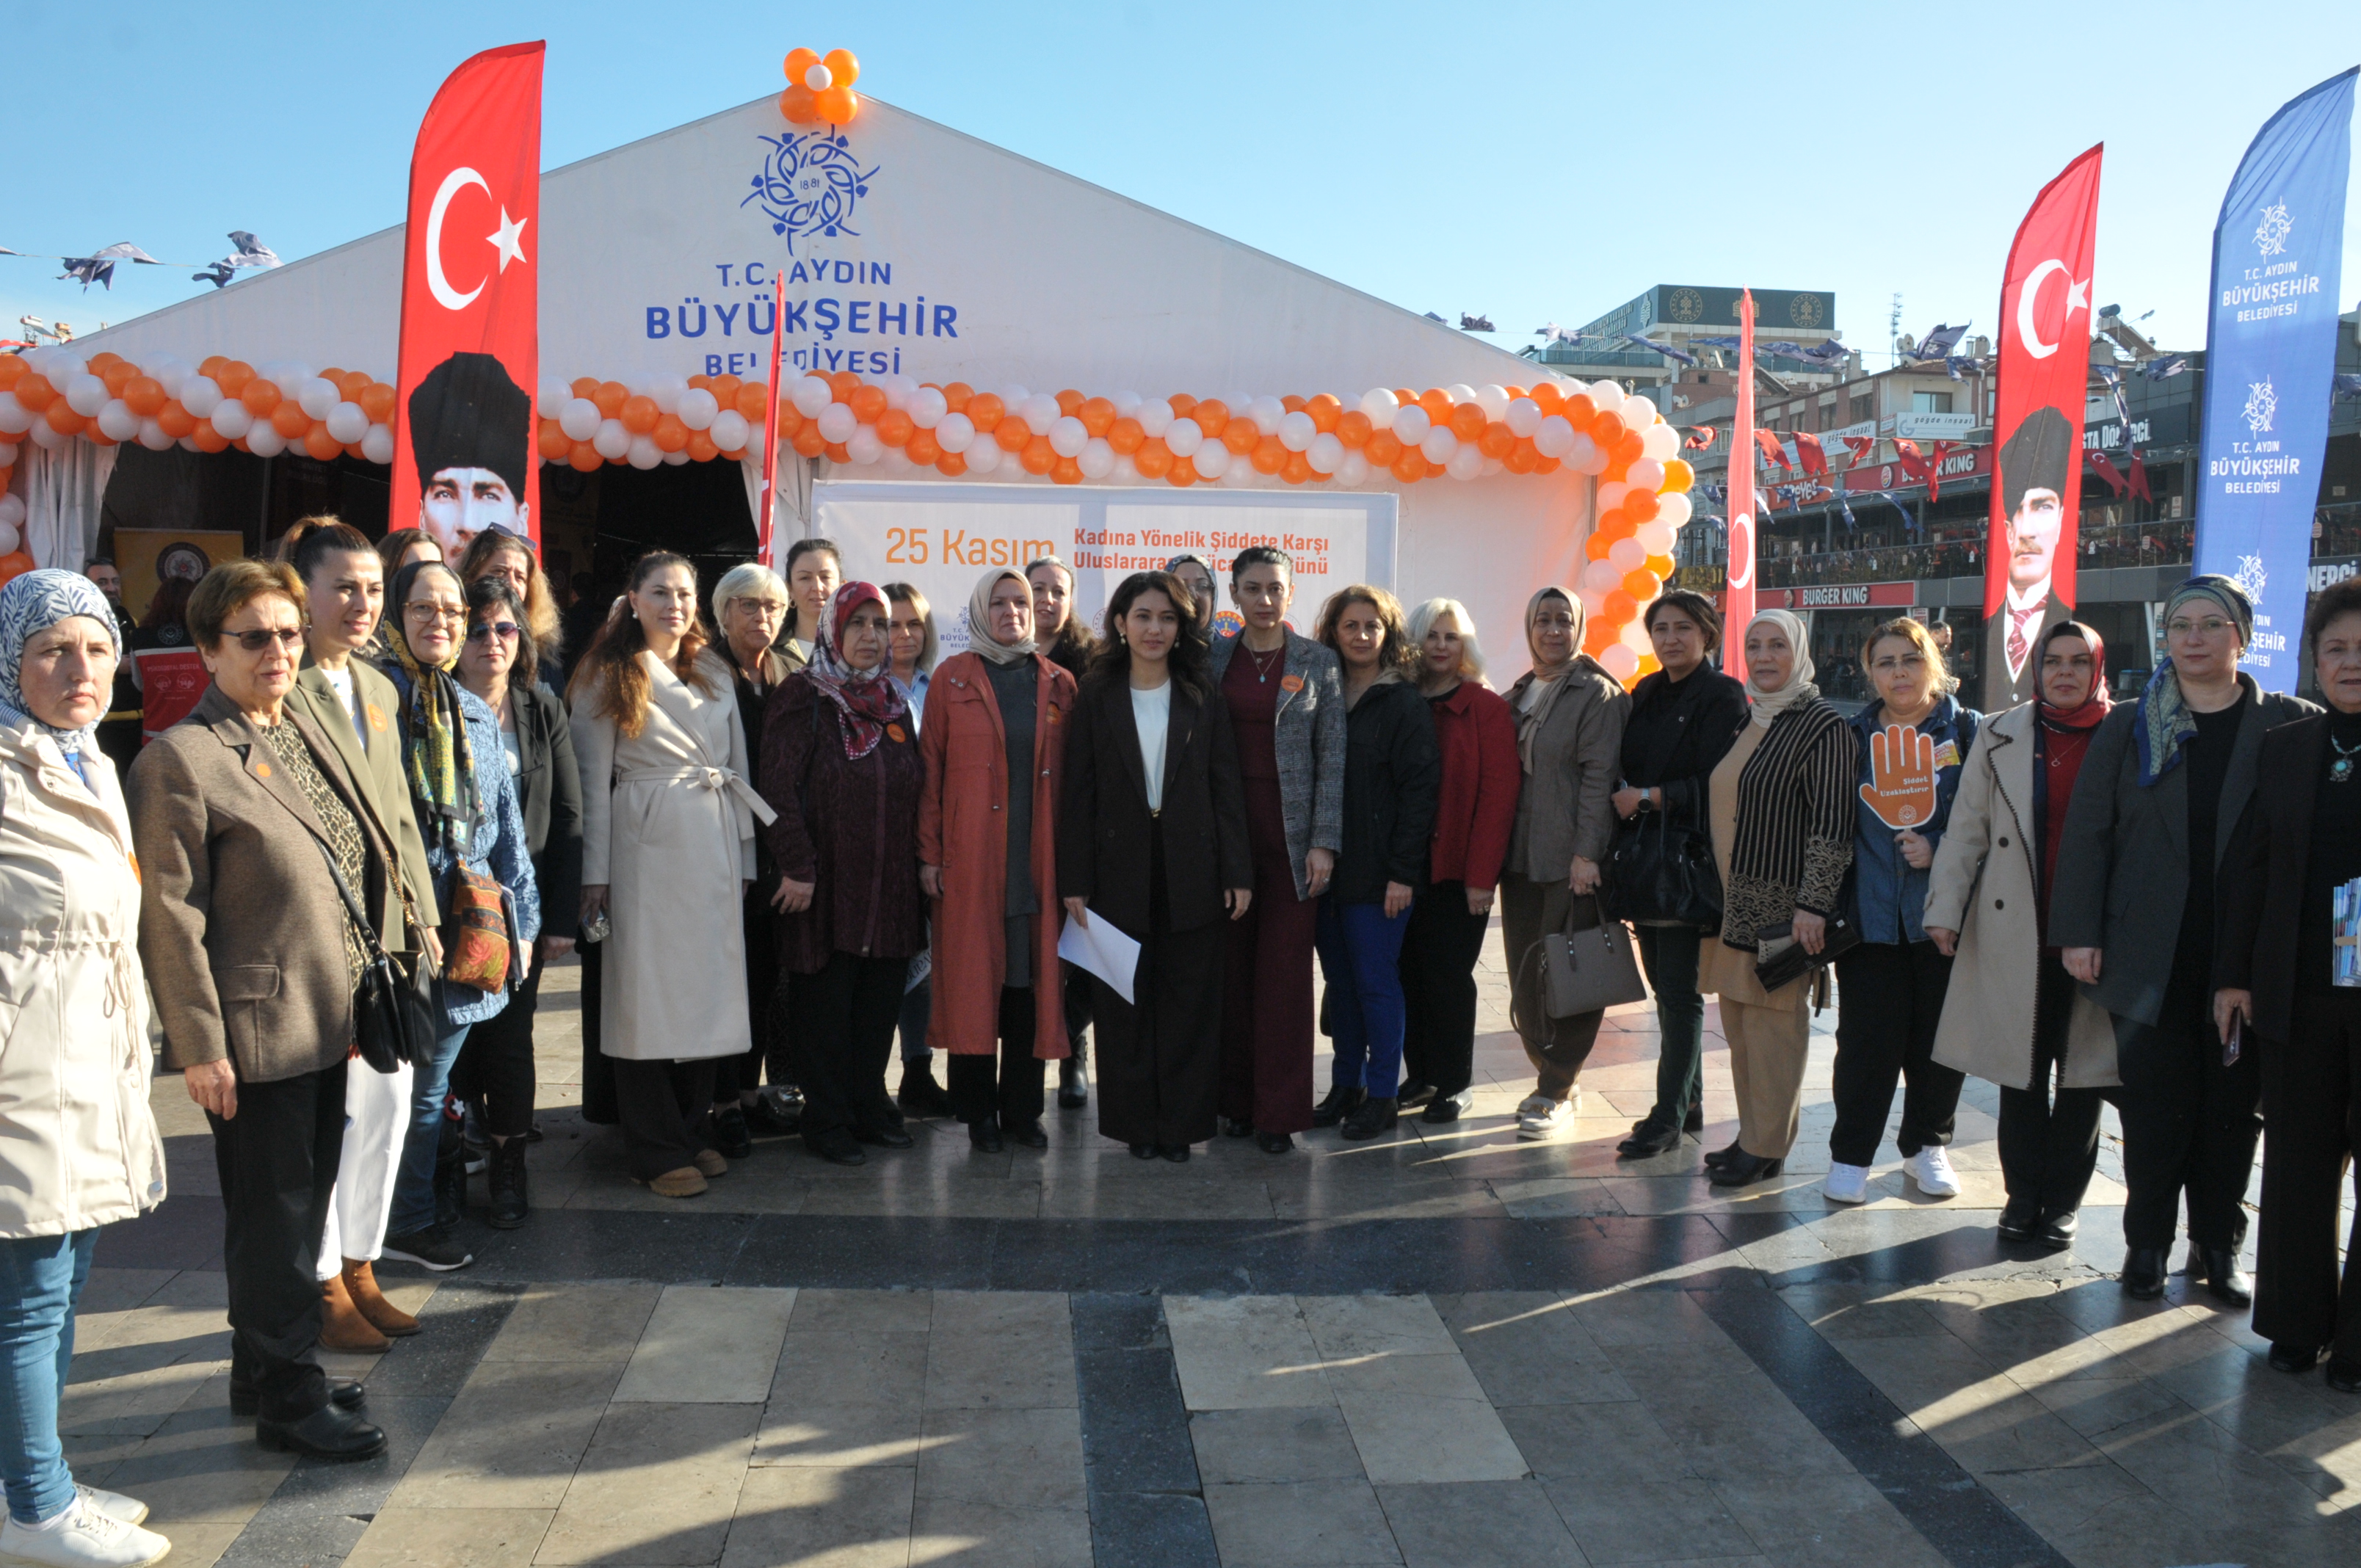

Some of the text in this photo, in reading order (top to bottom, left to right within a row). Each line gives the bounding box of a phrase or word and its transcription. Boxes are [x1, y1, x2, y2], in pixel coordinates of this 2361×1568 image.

[800, 178, 820, 190] 1881
[715, 258, 892, 287] T.C. AYDIN
[2244, 261, 2298, 280] T.C. AYDIN
[2222, 274, 2319, 306] BÜYÜKŞEHİR
[646, 294, 959, 341] BÜYÜKŞEHİR
[2237, 300, 2298, 322] BELEDİYESİ
[2233, 440, 2280, 454] T.C. AYDIN
[1945, 453, 1975, 475] KING
[2211, 454, 2300, 479] BÜYÜKŞEHİR
[2225, 479, 2280, 493] BELEDİYESİ
[885, 527, 1055, 566] 25 Kasım
[1074, 528, 1328, 555] Kadına Yönelik Şiddete Karşı
[1074, 552, 1327, 574] Uluslarara ünü
[2306, 560, 2357, 592] NERCİ
[1802, 587, 1840, 606] BURGER
[1842, 586, 1868, 604] KING
[2253, 614, 2271, 627] YDIN
[2248, 631, 2285, 652] ŞEHİR
[2237, 651, 2271, 668] DİYESİ
[1903, 775, 1929, 785] Şiddet
[1880, 787, 1929, 797] Uzaklaştırır
